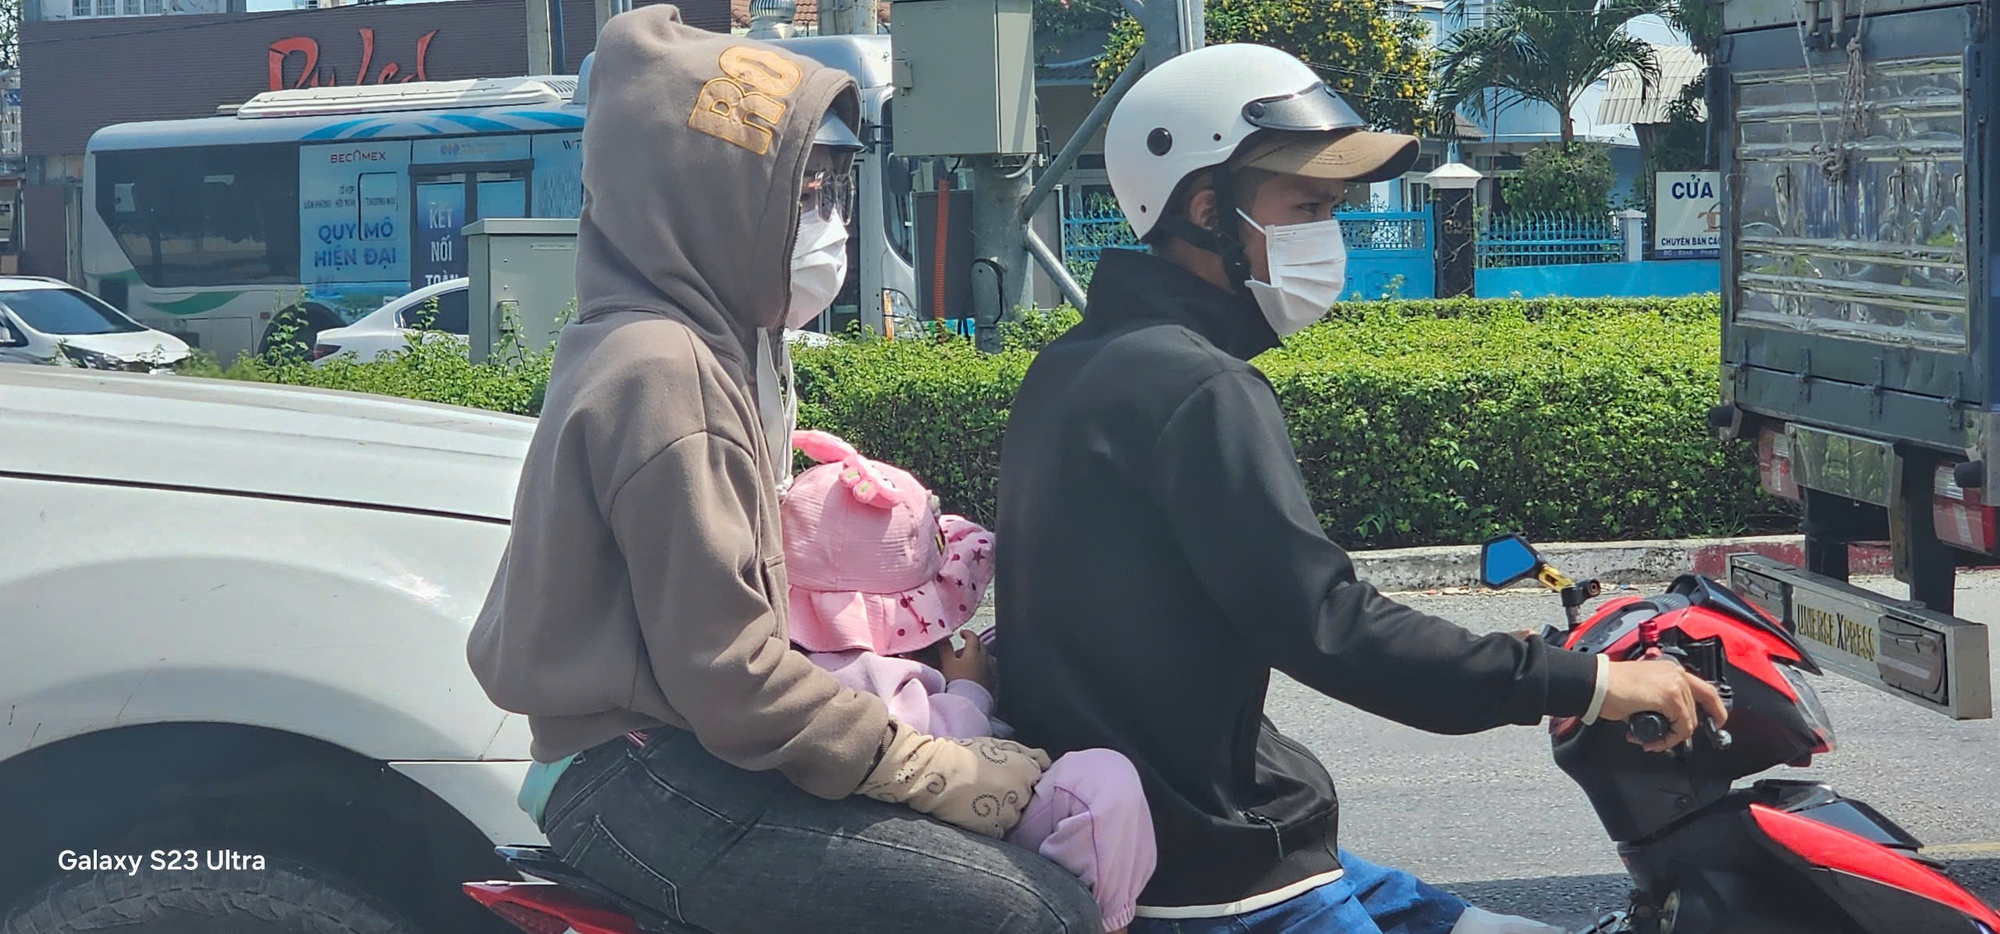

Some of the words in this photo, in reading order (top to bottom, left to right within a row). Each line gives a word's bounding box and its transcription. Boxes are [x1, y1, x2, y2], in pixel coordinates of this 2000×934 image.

[688, 46, 803, 156] RO
[1671, 174, 1714, 200] CỬA
[318, 223, 356, 245] QUY
[364, 216, 394, 239] MÔ
[1661, 235, 1690, 246] CHUYÊN
[1708, 234, 1720, 245] CÁ
[314, 246, 356, 271] HIỆN
[363, 247, 396, 270] ĐẠI
[431, 235, 453, 262] NỐI
